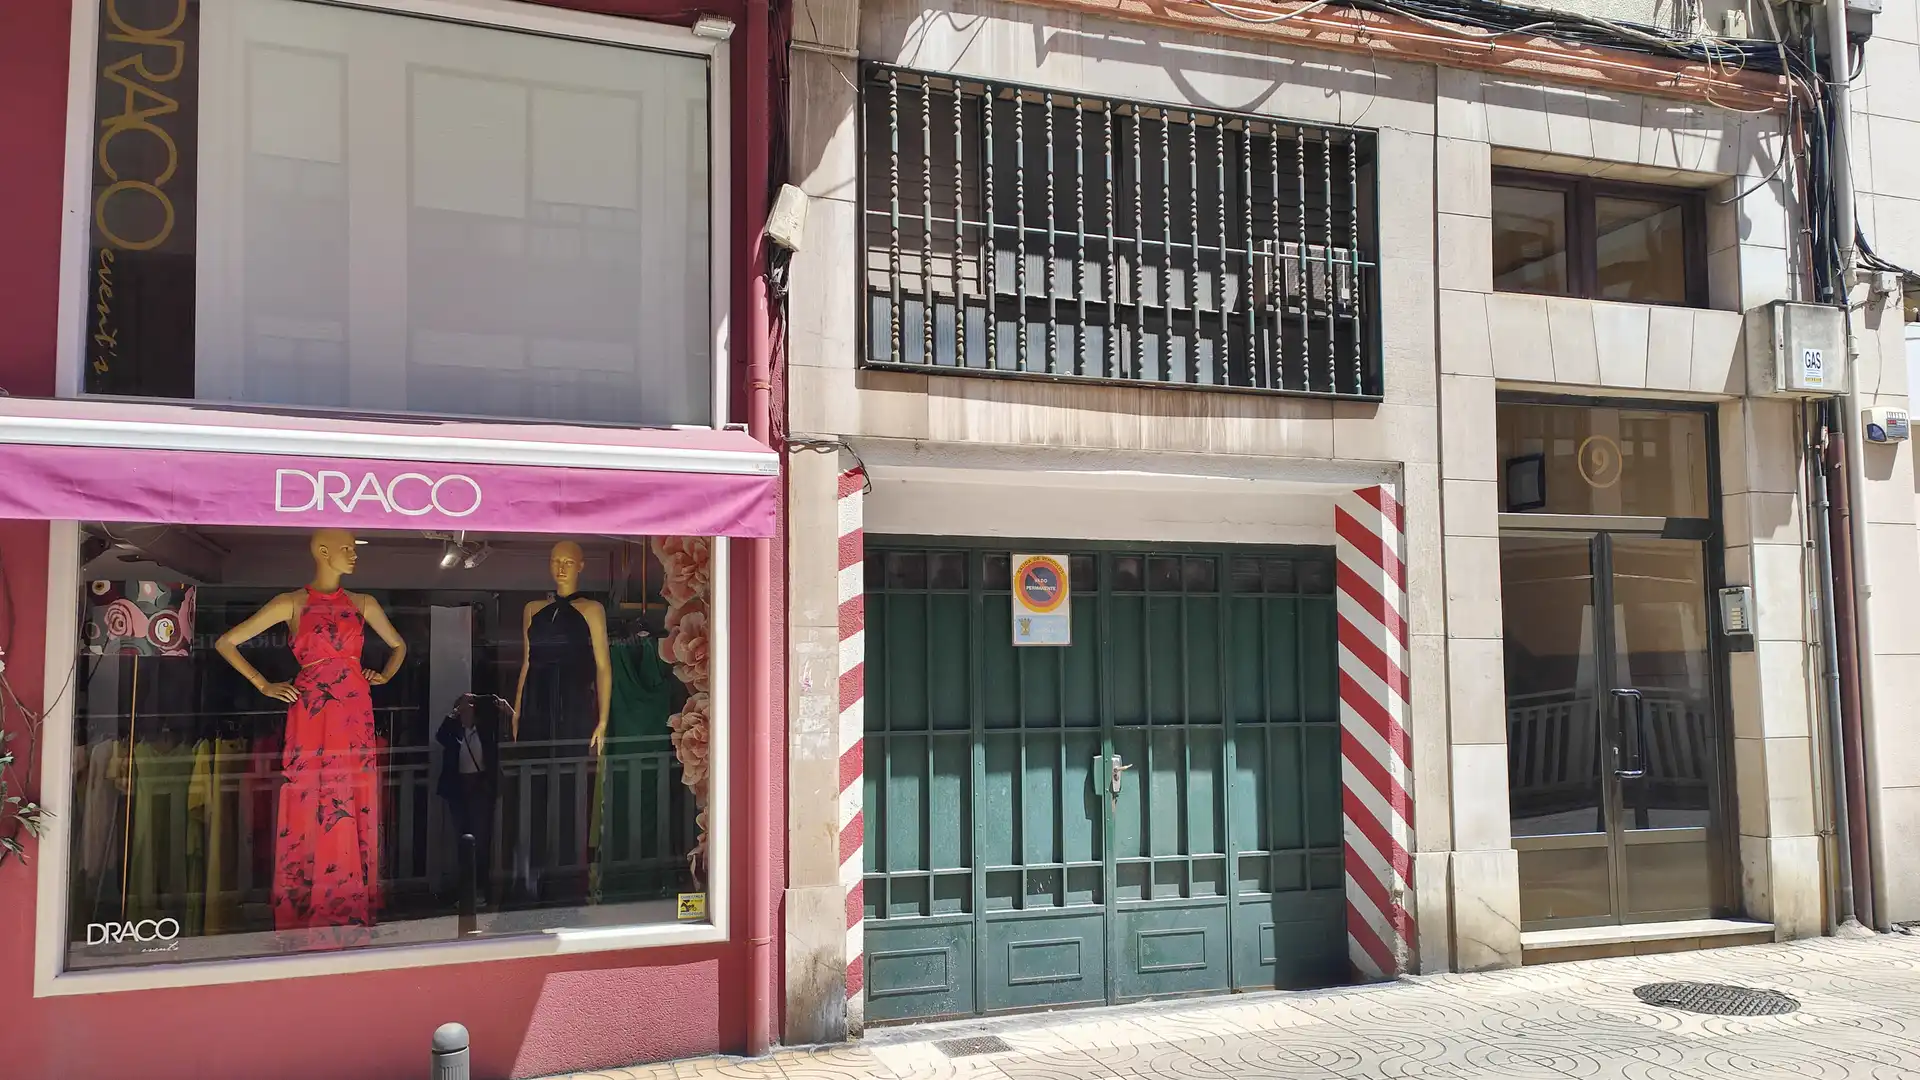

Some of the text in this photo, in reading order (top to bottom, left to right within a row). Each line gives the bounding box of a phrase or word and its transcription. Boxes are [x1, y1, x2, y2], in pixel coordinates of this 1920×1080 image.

[96, 0, 187, 250] DRACO
[1804, 351, 1822, 369] GAS
[1591, 447, 1609, 475] 9
[275, 468, 482, 517] DRACO
[87, 918, 179, 945] DRACO
